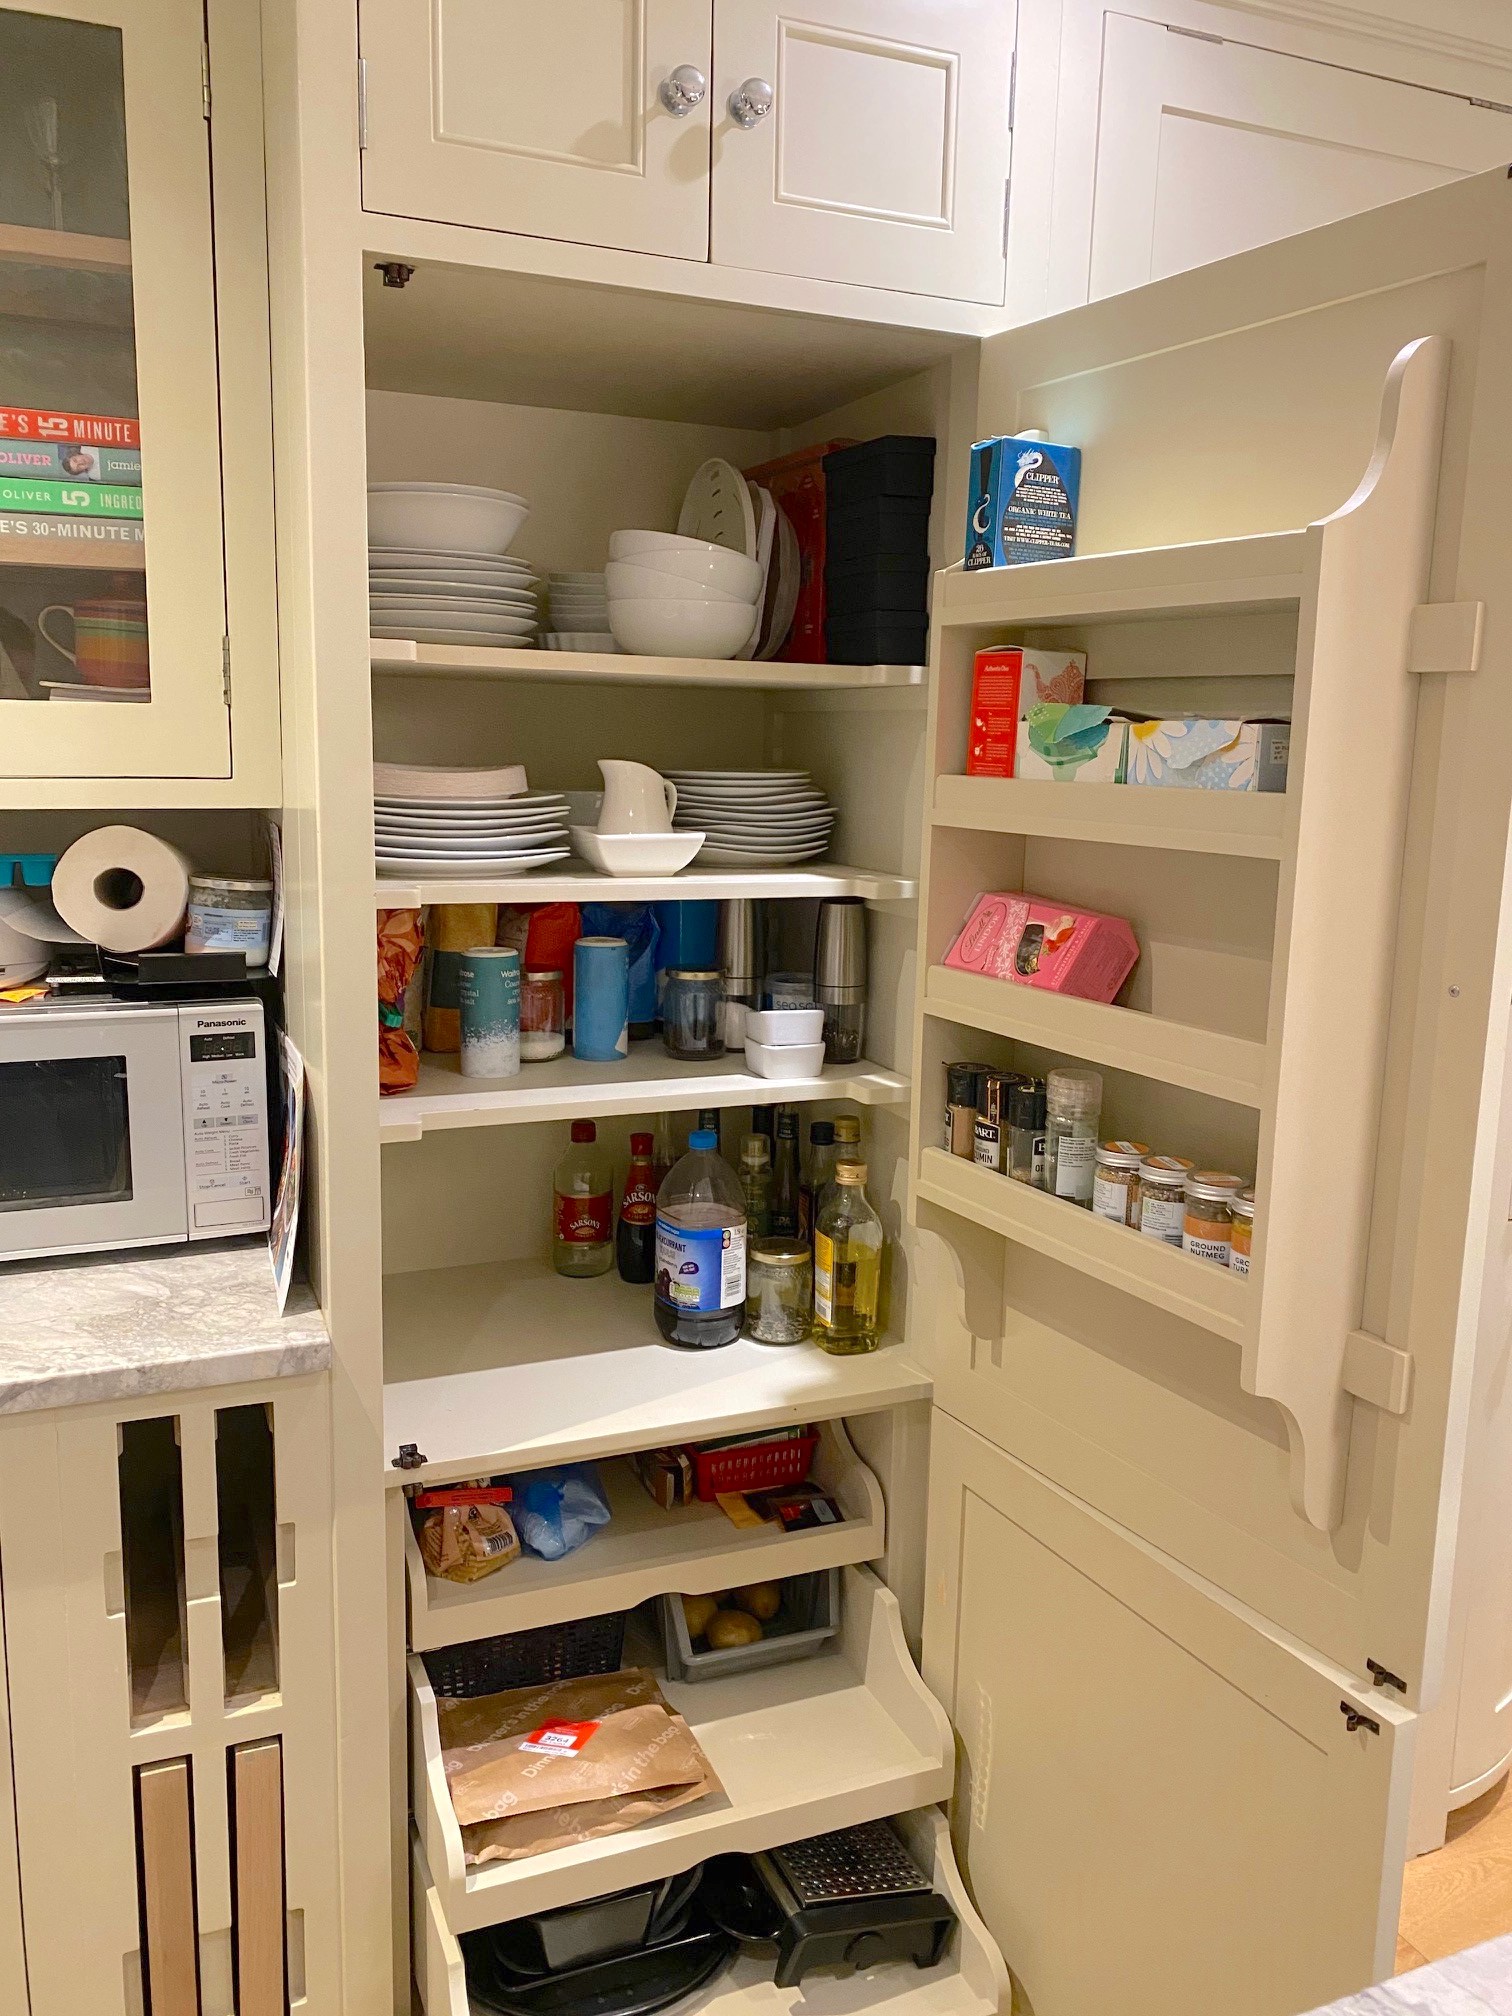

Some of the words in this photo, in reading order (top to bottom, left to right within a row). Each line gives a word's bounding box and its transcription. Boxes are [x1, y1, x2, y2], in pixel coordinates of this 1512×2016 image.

[73, 419, 132, 443] MINUTE
[0, 451, 52, 466] OLIVER
[1026, 472, 1060, 485] CLIPPER
[2, 489, 52, 502] OLIVER
[62, 490, 90, 507] 5
[1008, 505, 1037, 516] ORGANIC
[1037, 508, 1059, 518] WHITE
[1059, 512, 1072, 520] TEA
[0, 520, 28, 534] E'S
[32, 521, 130, 541] 30-MINUTE
[967, 557, 991, 567] CLIPPER
[975, 915, 999, 952] LINDOR
[197, 1019, 247, 1028] Panasonic
[1190, 1240, 1226, 1252] GROUND
[1190, 1248, 1225, 1260] NUTMEG
[651, 1725, 682, 1745] bag
